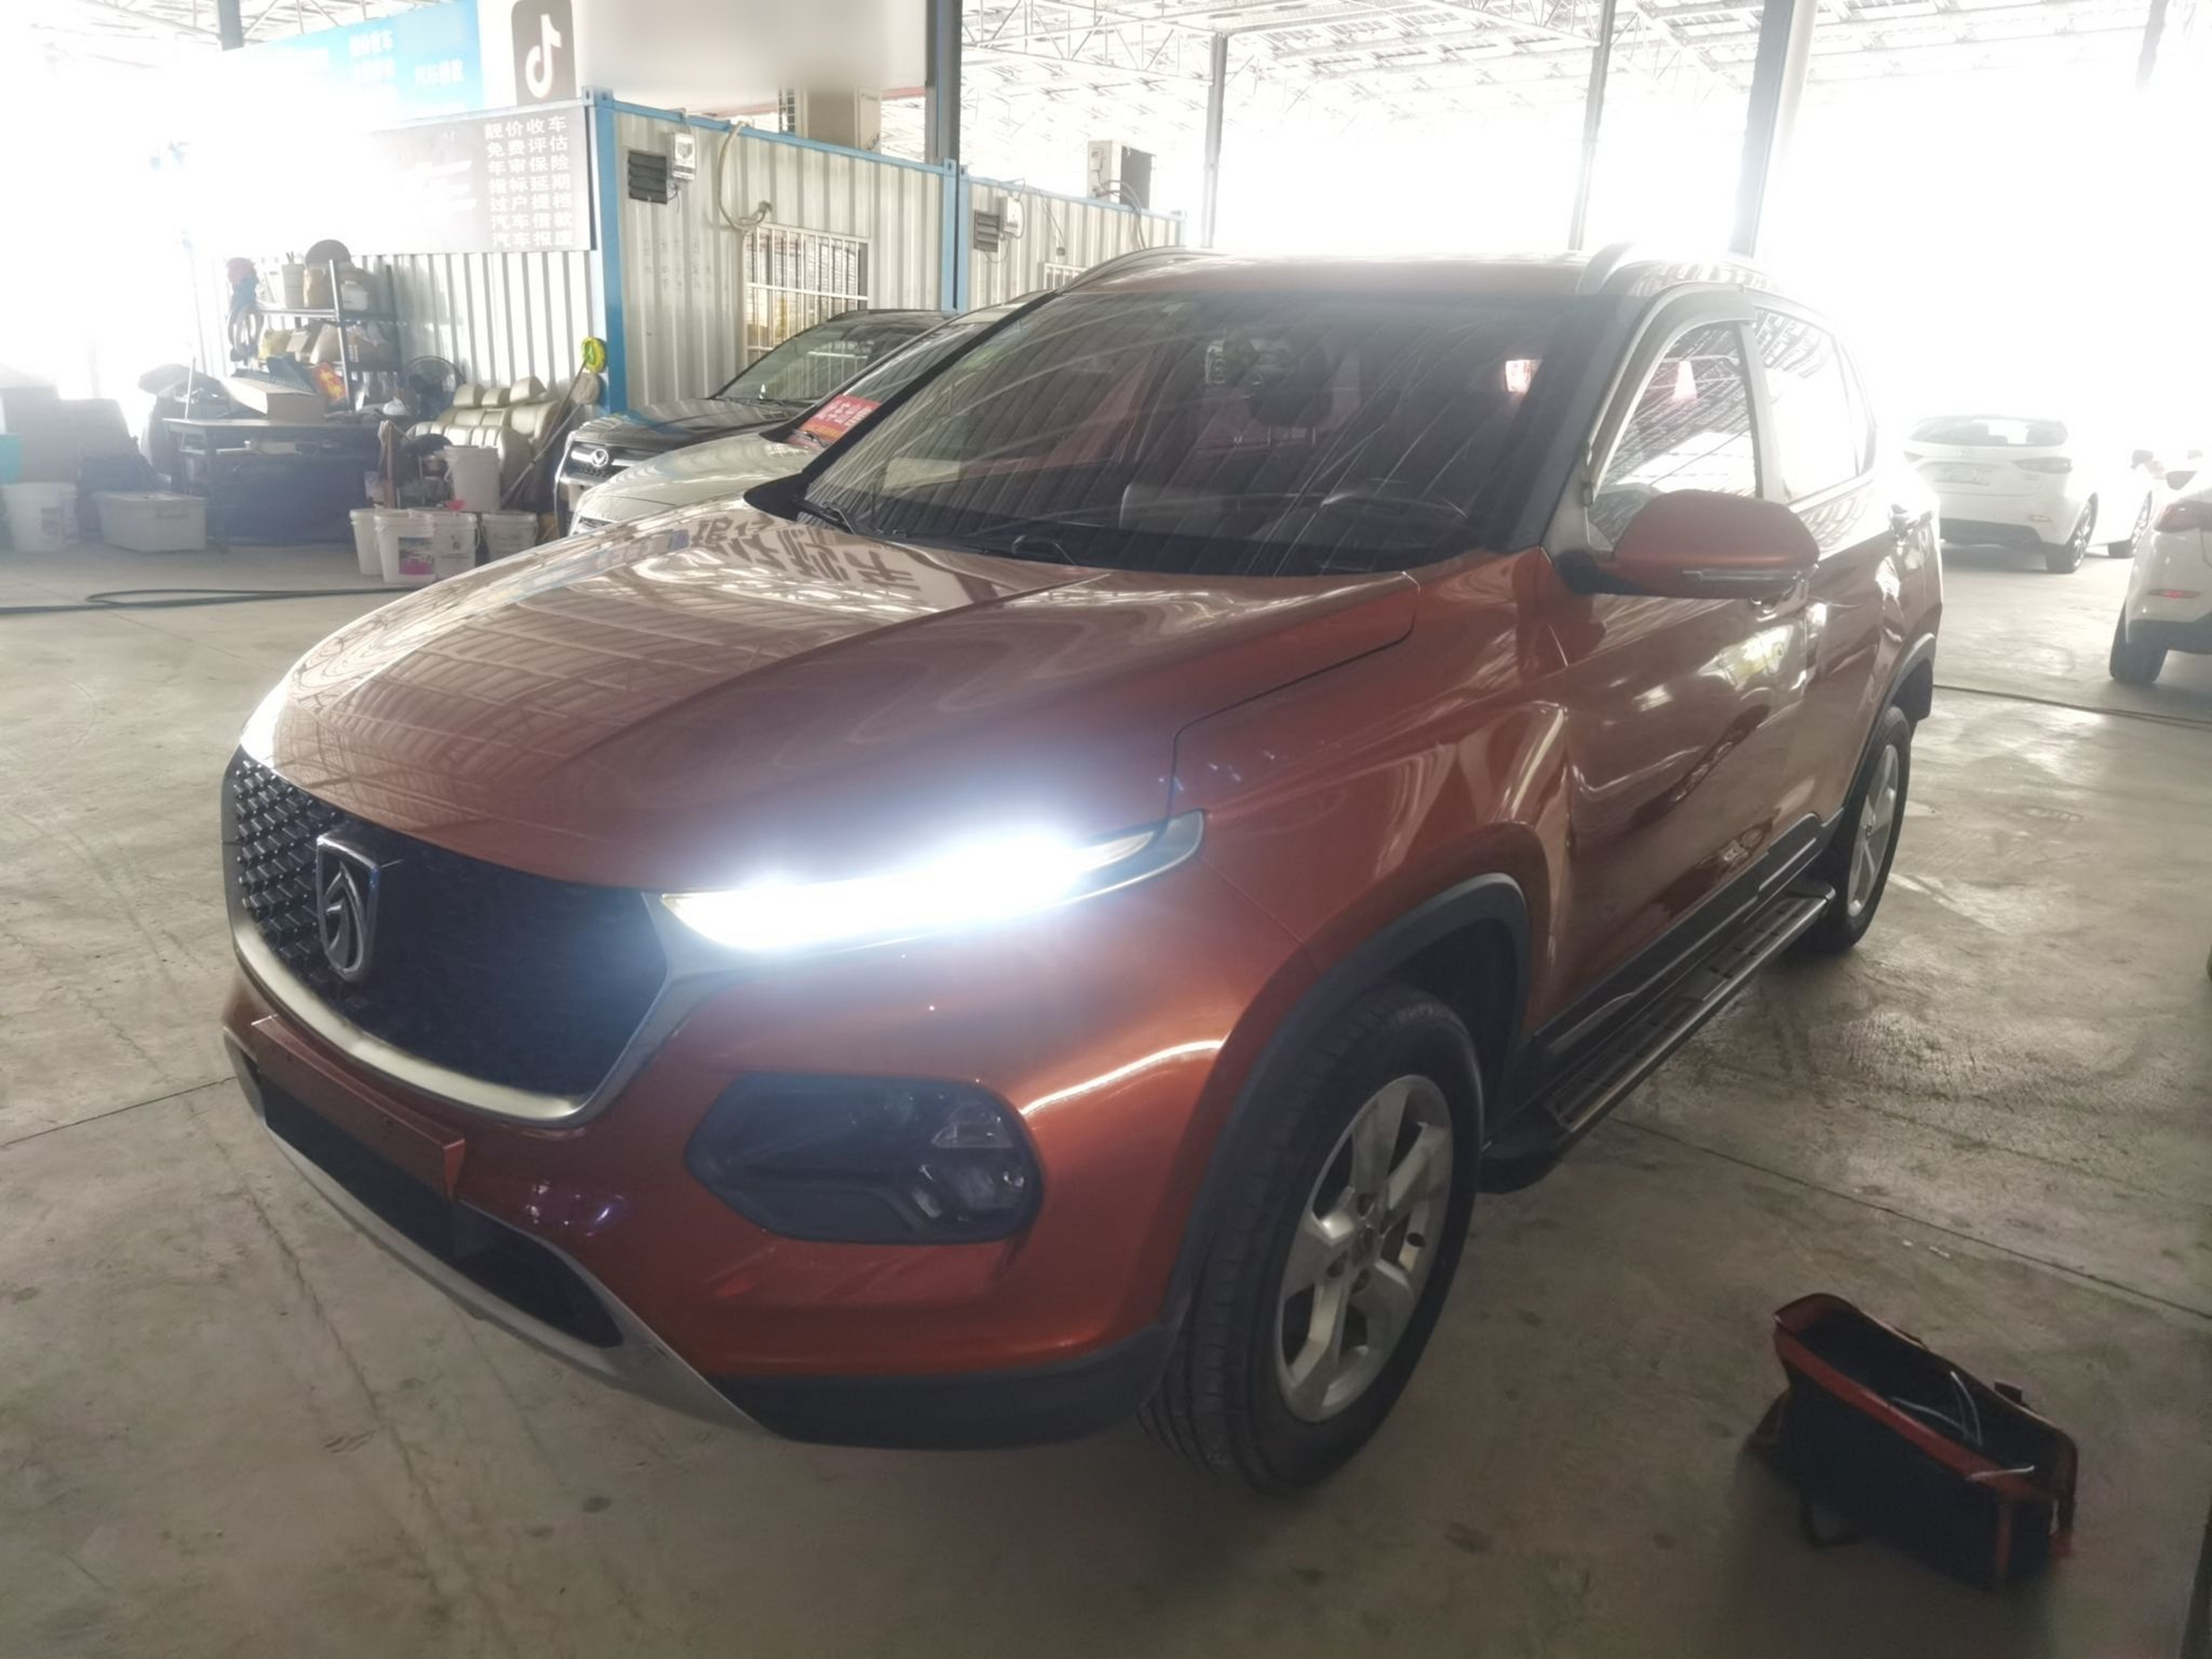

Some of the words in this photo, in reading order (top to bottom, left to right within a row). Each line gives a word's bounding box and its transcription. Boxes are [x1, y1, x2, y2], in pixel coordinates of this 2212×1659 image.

[486, 135, 569, 158] 免费评估
[488, 154, 570, 176] 年审保险
[488, 174, 571, 194] 指标延期
[490, 192, 572, 212] 过户提档
